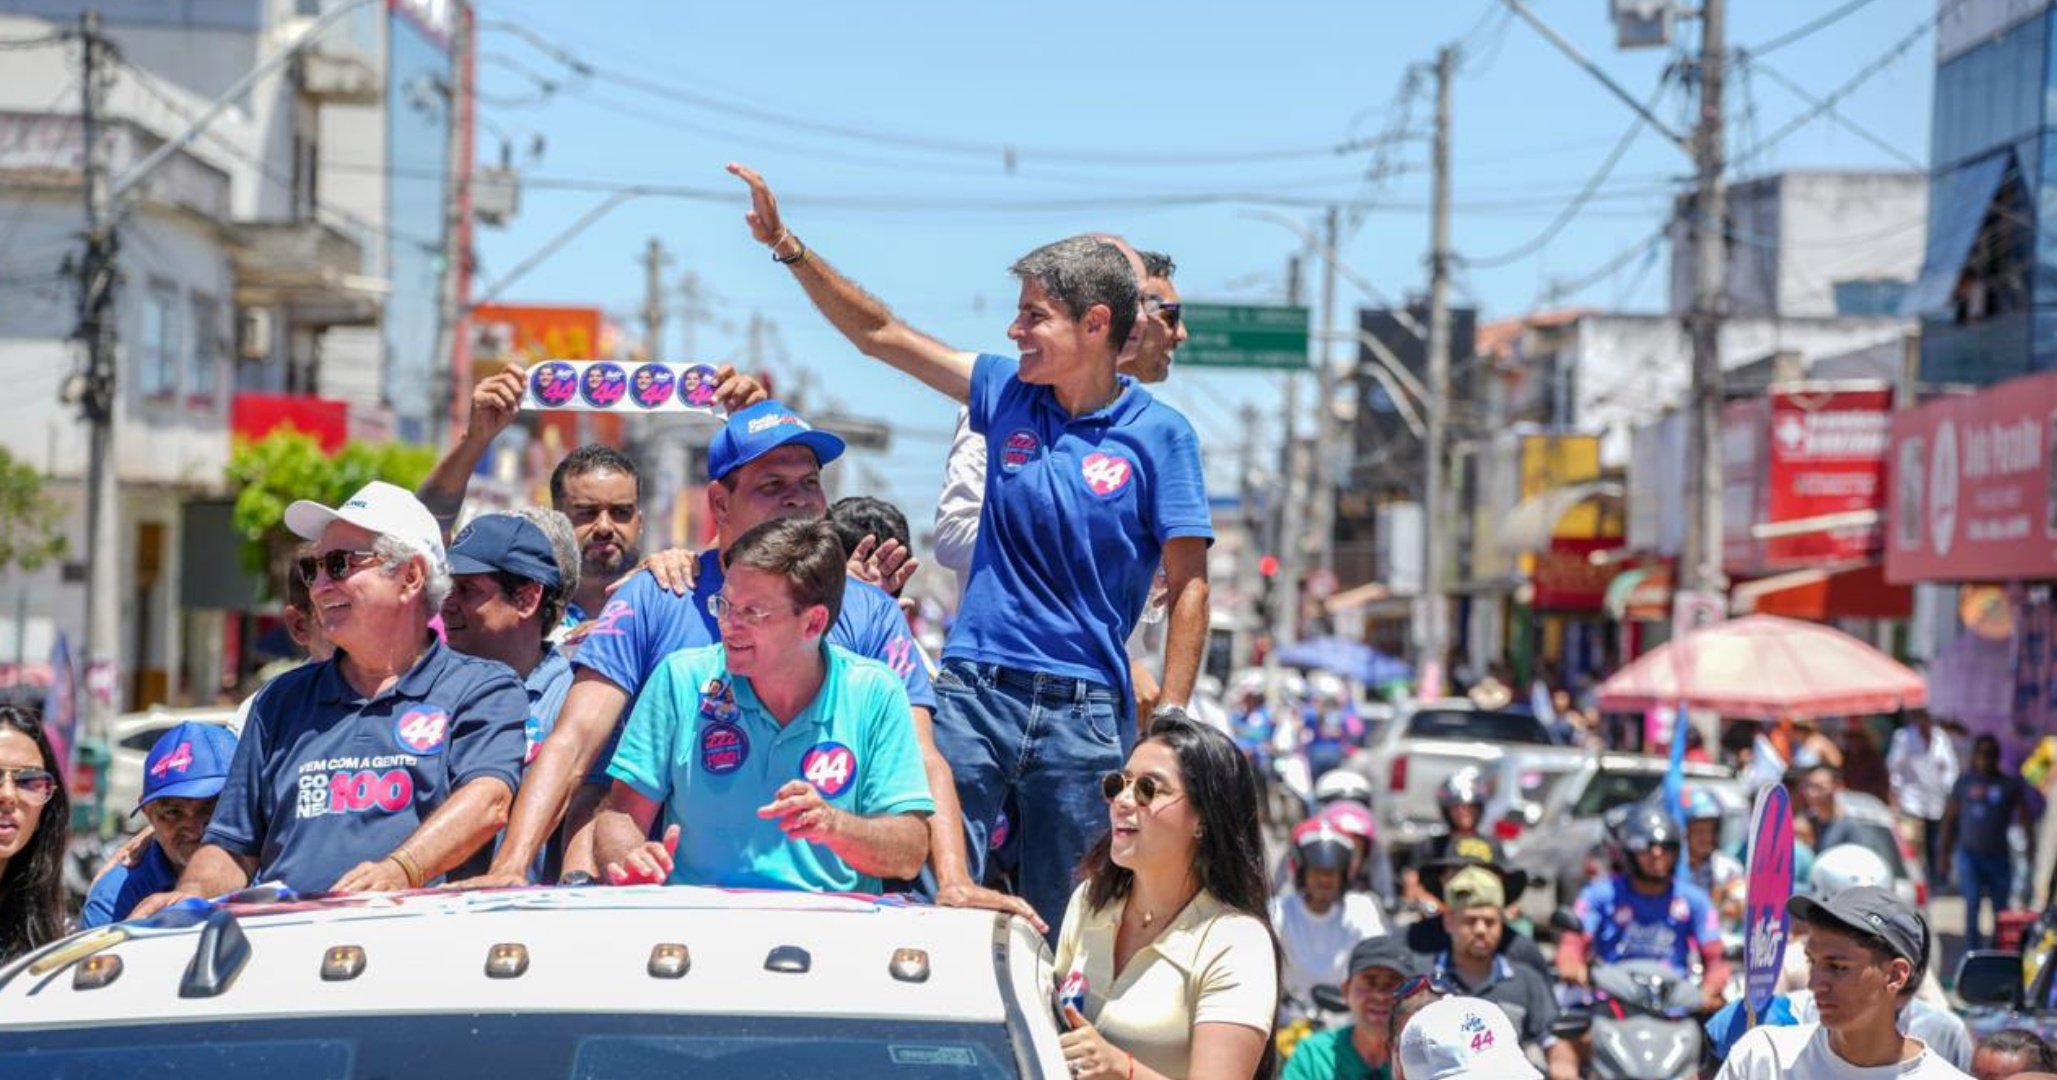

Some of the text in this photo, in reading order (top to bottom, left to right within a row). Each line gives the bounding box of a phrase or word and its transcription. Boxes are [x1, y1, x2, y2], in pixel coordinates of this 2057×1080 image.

[543, 380, 577, 403] 44
[592, 381, 626, 404] 44
[641, 383, 676, 405] 44
[1082, 457, 1127, 491] 44
[401, 714, 447, 745] 44
[298, 758, 326, 773] VEM
[328, 757, 358, 770] COM
[360, 758, 370, 768] A
[805, 752, 848, 787] 44
[298, 774, 329, 789] CO
[329, 769, 414, 814] 100
[297, 789, 327, 803] RO
[296, 803, 329, 819] NEL
[1471, 1029, 1495, 1050] 44
